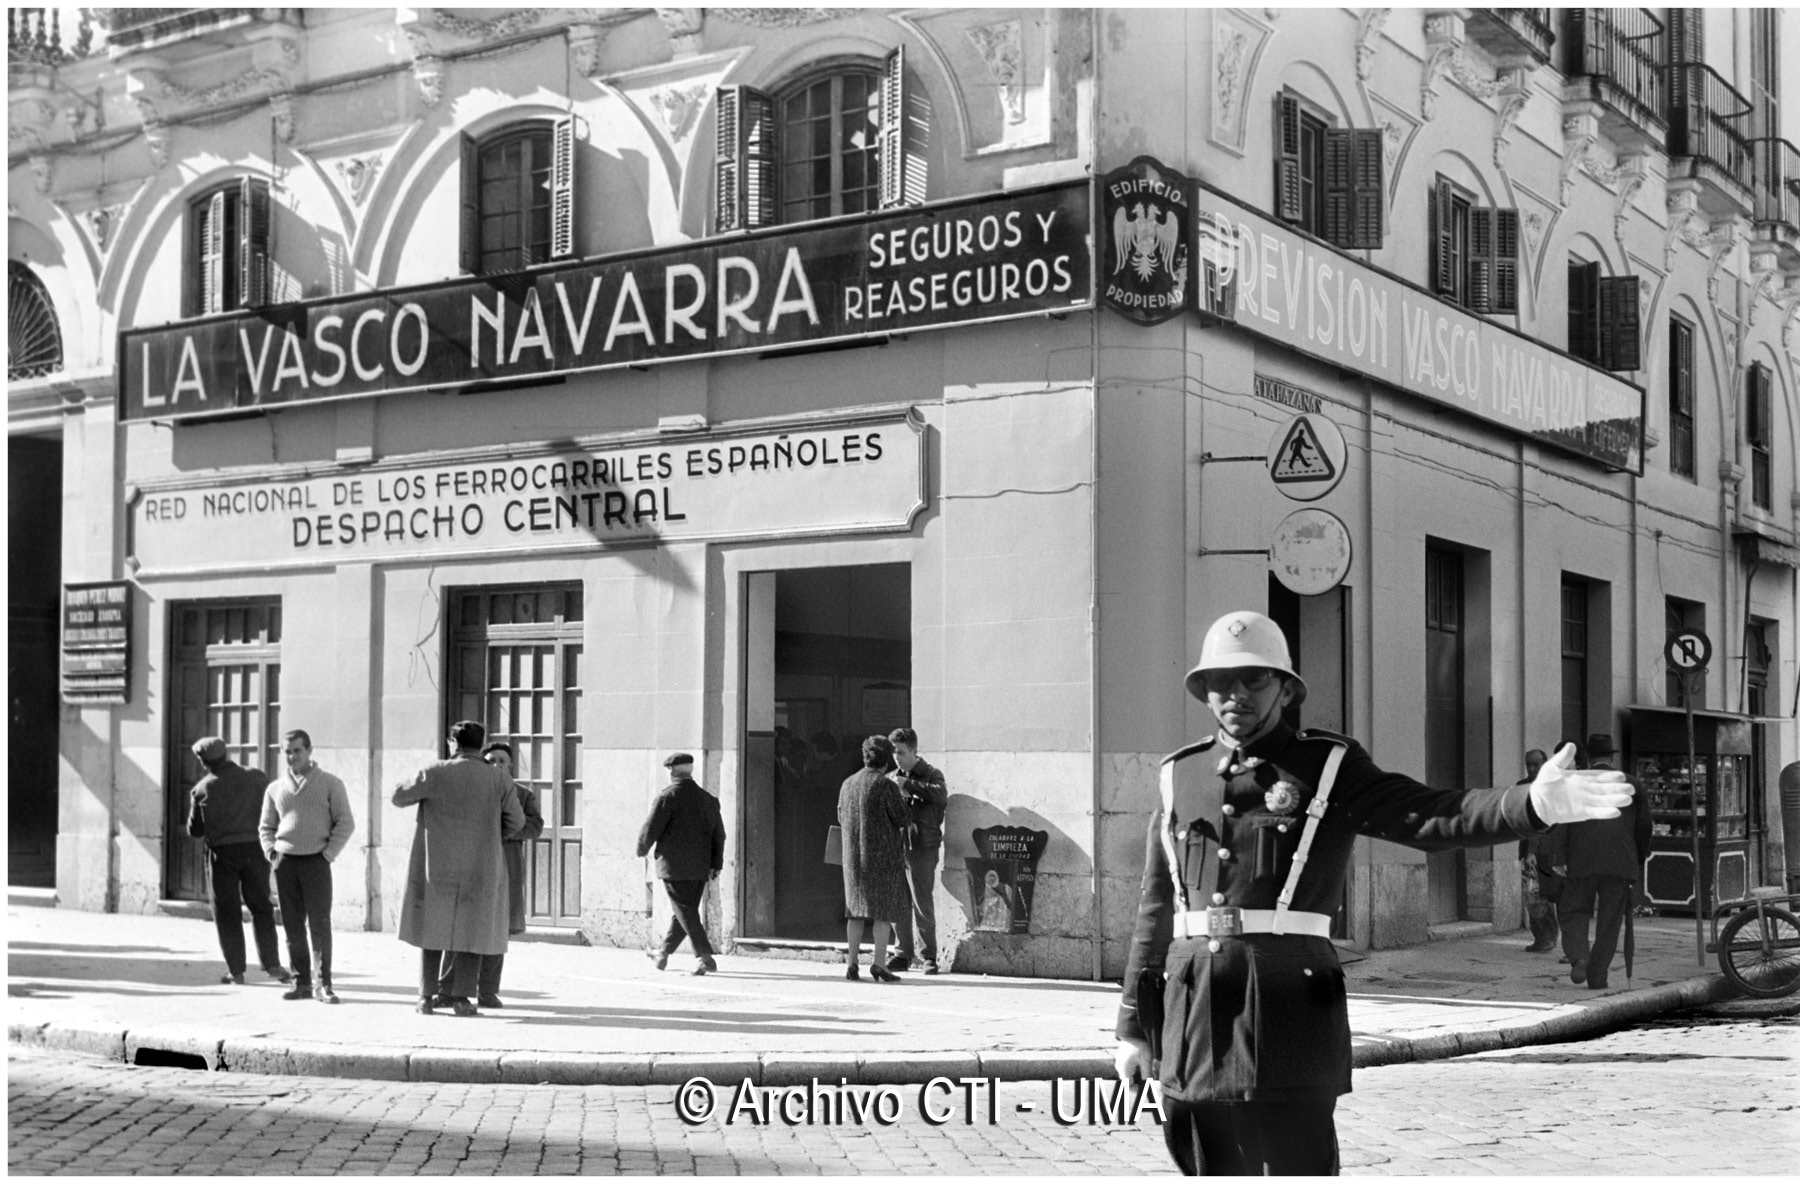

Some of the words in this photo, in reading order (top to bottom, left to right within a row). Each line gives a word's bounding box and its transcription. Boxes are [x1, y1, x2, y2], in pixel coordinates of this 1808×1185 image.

[1110, 179, 1182, 202] EDIFICIO
[869, 211, 1022, 268] SEGUROS
[1036, 211, 1057, 243] Y
[845, 255, 1072, 321] REASEGUROS
[1106, 285, 1184, 308] PROPIEDAD
[143, 336, 207, 408] LA
[239, 303, 430, 396] VASCO
[471, 247, 820, 368] NAVARRA
[1215, 212, 1388, 368] PREVISION
[1402, 300, 1480, 401] VASCO
[1492, 341, 1586, 443] NAVARRA
[146, 498, 187, 521] RED
[203, 486, 317, 517] NACIONAL
[333, 480, 363, 506] DE
[379, 476, 426, 502] LOS
[436, 452, 672, 497] FERROCARRILES
[686, 433, 883, 476] ESPAÑOLES
[293, 503, 483, 547] DESPACHO
[504, 487, 686, 532] CENTRAL
[993, 843, 1028, 852] LIMPIEZA
